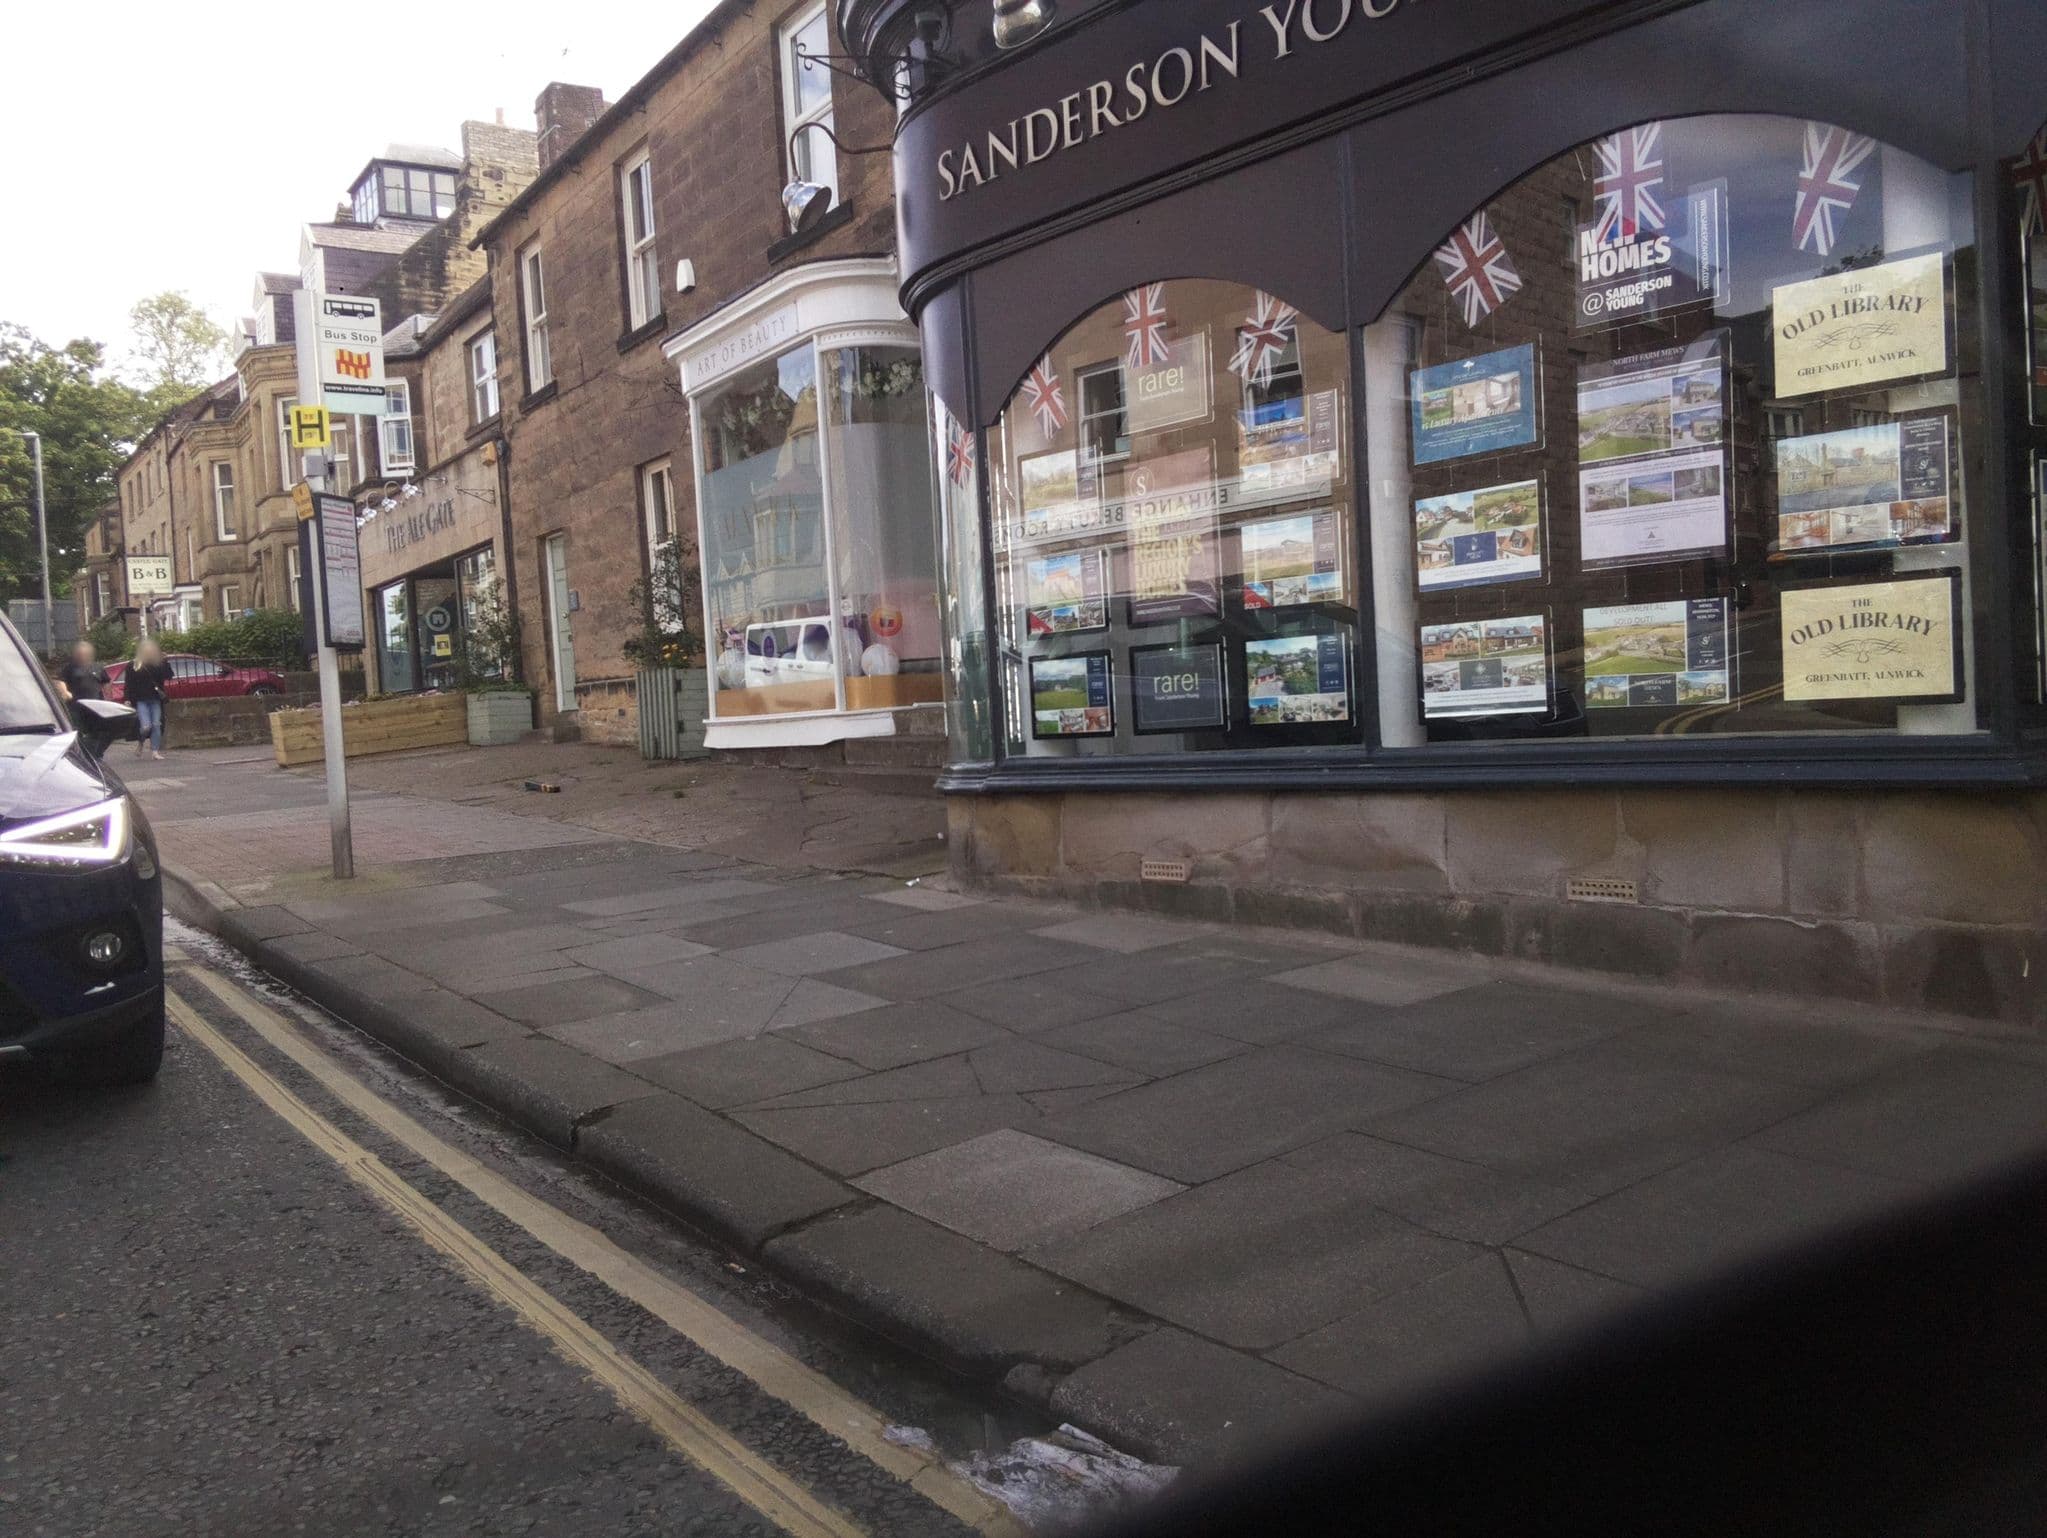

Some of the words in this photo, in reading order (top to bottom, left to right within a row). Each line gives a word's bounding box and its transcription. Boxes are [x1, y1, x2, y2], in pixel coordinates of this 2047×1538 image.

[937, 20, 1242, 201] SANDERSON
[1581, 236, 1673, 282] HOMES
[1582, 292, 1604, 316] @
[1605, 275, 1673, 300] SANDERSON
[1606, 294, 1644, 312] YOUNG
[1782, 309, 1825, 340] OLD
[1831, 294, 1929, 320] LIBRARY
[325, 329, 347, 341] Bus
[350, 330, 378, 344] Stop
[697, 353, 717, 377] ART
[721, 343, 736, 363] OF
[740, 315, 787, 354] BEAUTY
[1612, 354, 1638, 366] NORTH
[1639, 351, 1660, 363] FARM
[1661, 347, 1684, 359] MEWS
[1866, 348, 1917, 365] ALNWICK
[325, 384, 384, 395] www.traveline.info
[1138, 366, 1184, 395] rare!
[296, 410, 324, 443] H
[386, 522, 407, 554] THE
[1851, 598, 1873, 608] THE
[1790, 618, 1834, 646] OLD
[1839, 611, 1937, 637] LIBRARY
[1153, 672, 1199, 694] rare!
[1873, 669, 1926, 681] ALNWICK
